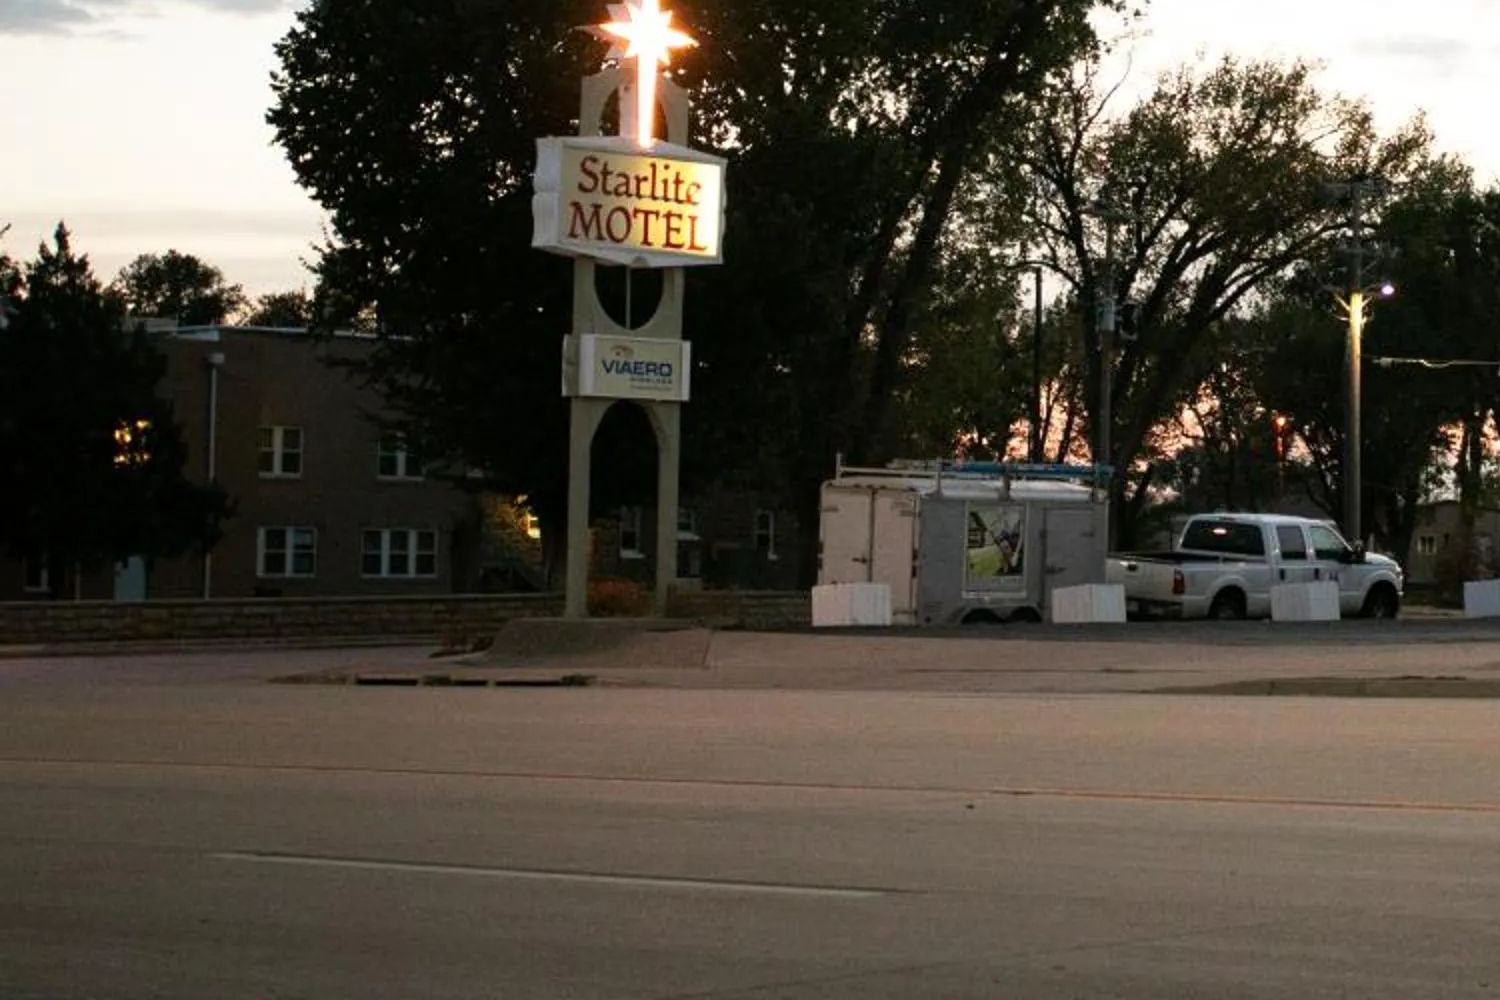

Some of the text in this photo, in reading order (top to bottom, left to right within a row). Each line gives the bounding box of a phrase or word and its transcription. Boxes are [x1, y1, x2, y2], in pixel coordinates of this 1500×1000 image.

[577, 155, 702, 206] Starlite
[567, 200, 708, 252] MOTEL
[601, 359, 673, 377] VIAERO
